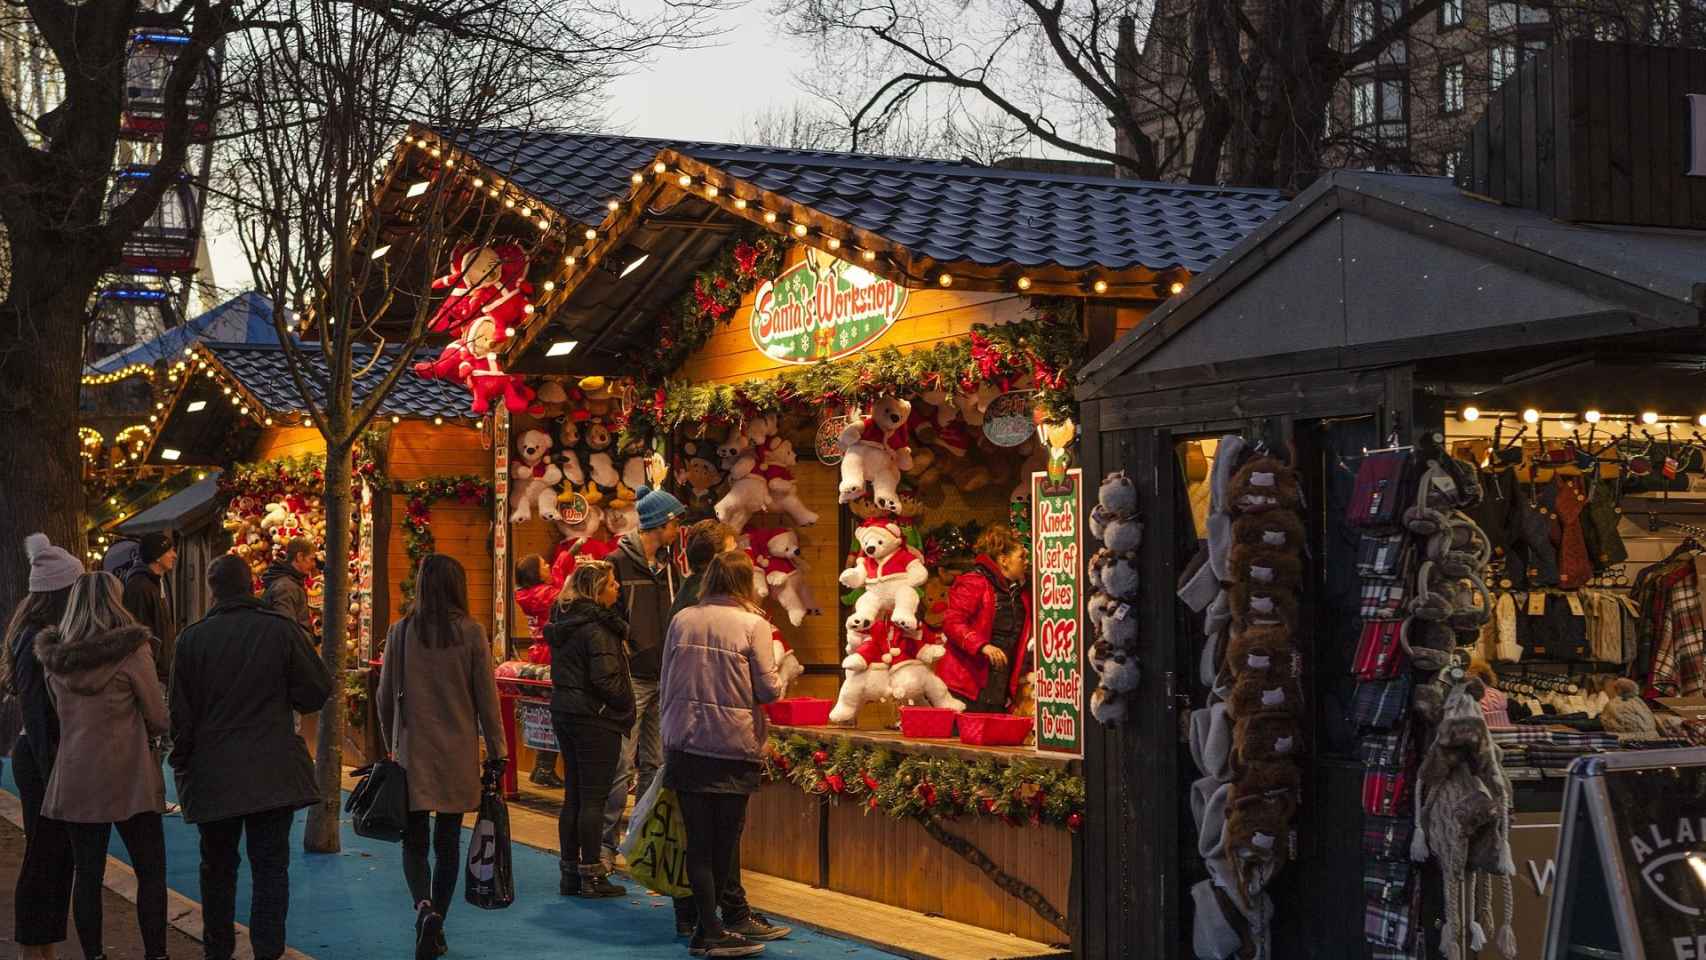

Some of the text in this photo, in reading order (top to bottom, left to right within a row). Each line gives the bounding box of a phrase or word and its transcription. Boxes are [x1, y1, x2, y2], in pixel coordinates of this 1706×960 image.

[759, 284, 815, 341] Santa's
[1040, 501, 1073, 535] Knock
[1037, 538, 1077, 578] 1 set of
[1041, 573, 1073, 608] Elves
[1037, 668, 1080, 710] the shelf
[1042, 708, 1074, 739] to win
